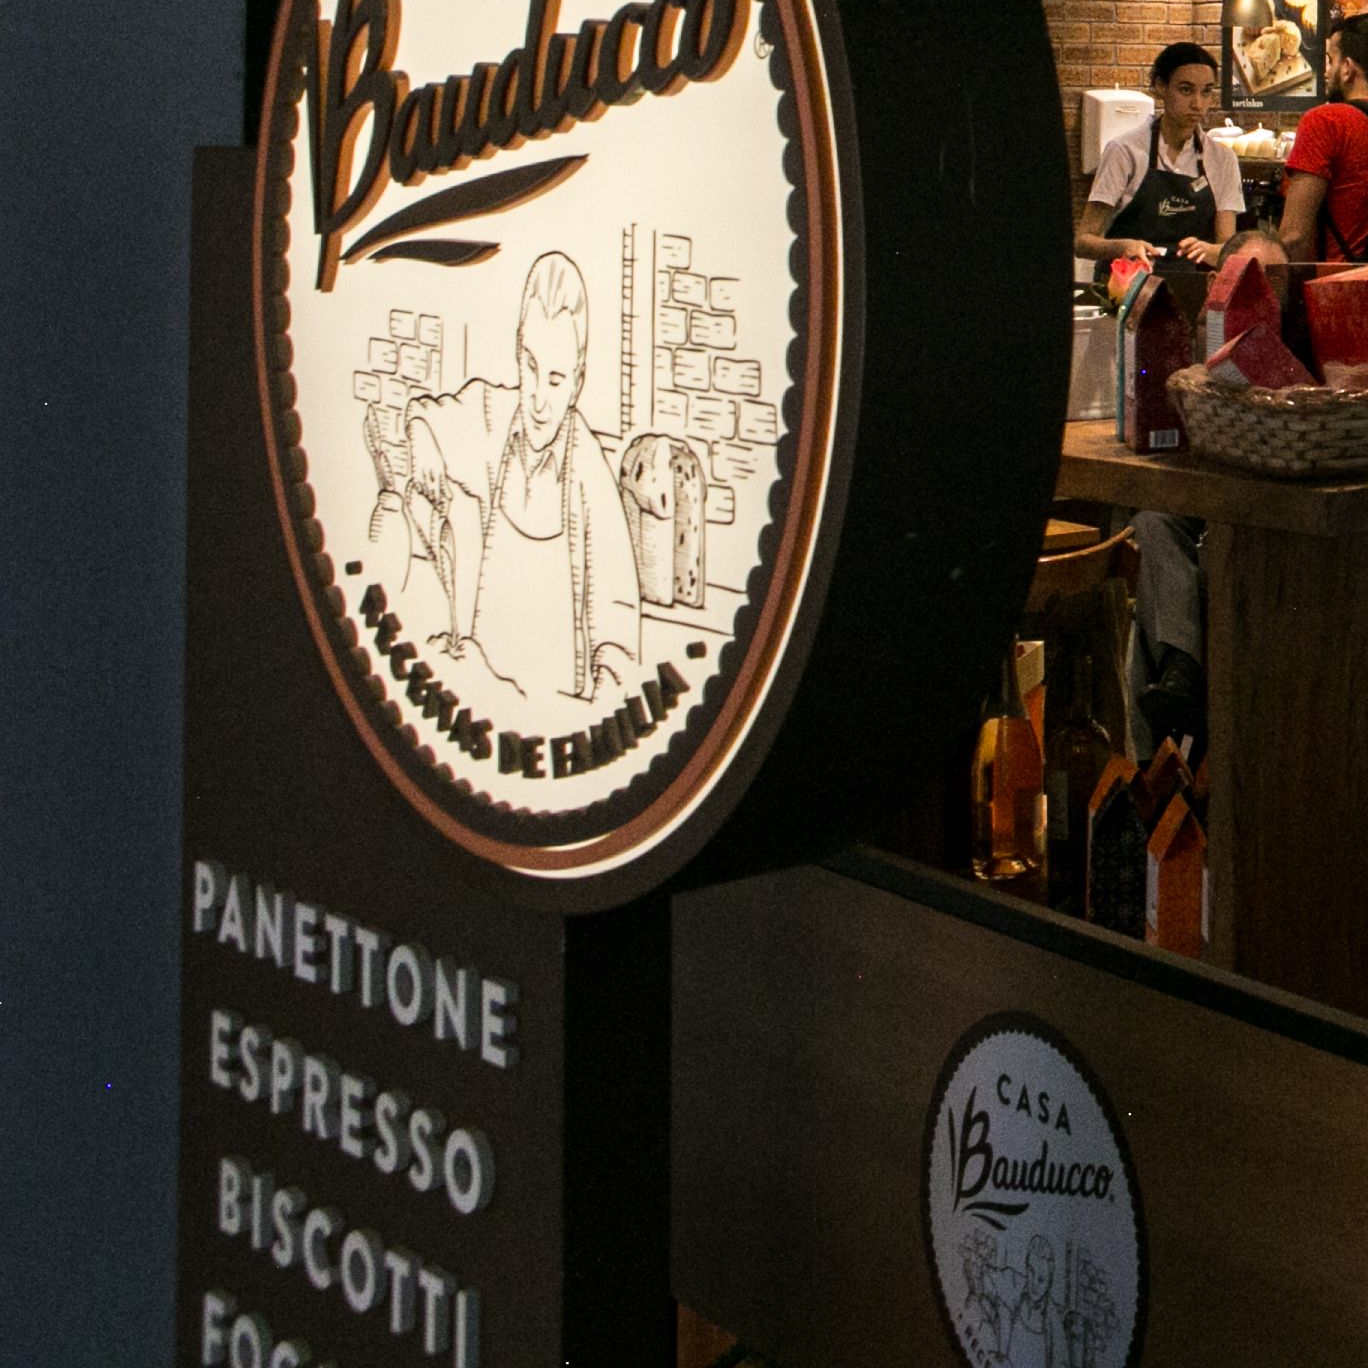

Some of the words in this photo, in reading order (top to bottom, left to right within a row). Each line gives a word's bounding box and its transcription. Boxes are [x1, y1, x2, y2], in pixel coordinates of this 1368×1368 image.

[358, 583, 495, 762] RECEITAS
[497, 730, 547, 780] DE
[194, 859, 520, 1070] PANETTONE
[210, 1008, 497, 1215] ESPRESSO
[949, 1086, 1114, 1214] Bauducco
[997, 1073, 1071, 1136] CASA
[202, 1289, 339, 1368] FO
[218, 1156, 481, 1368] BISCOTTI
